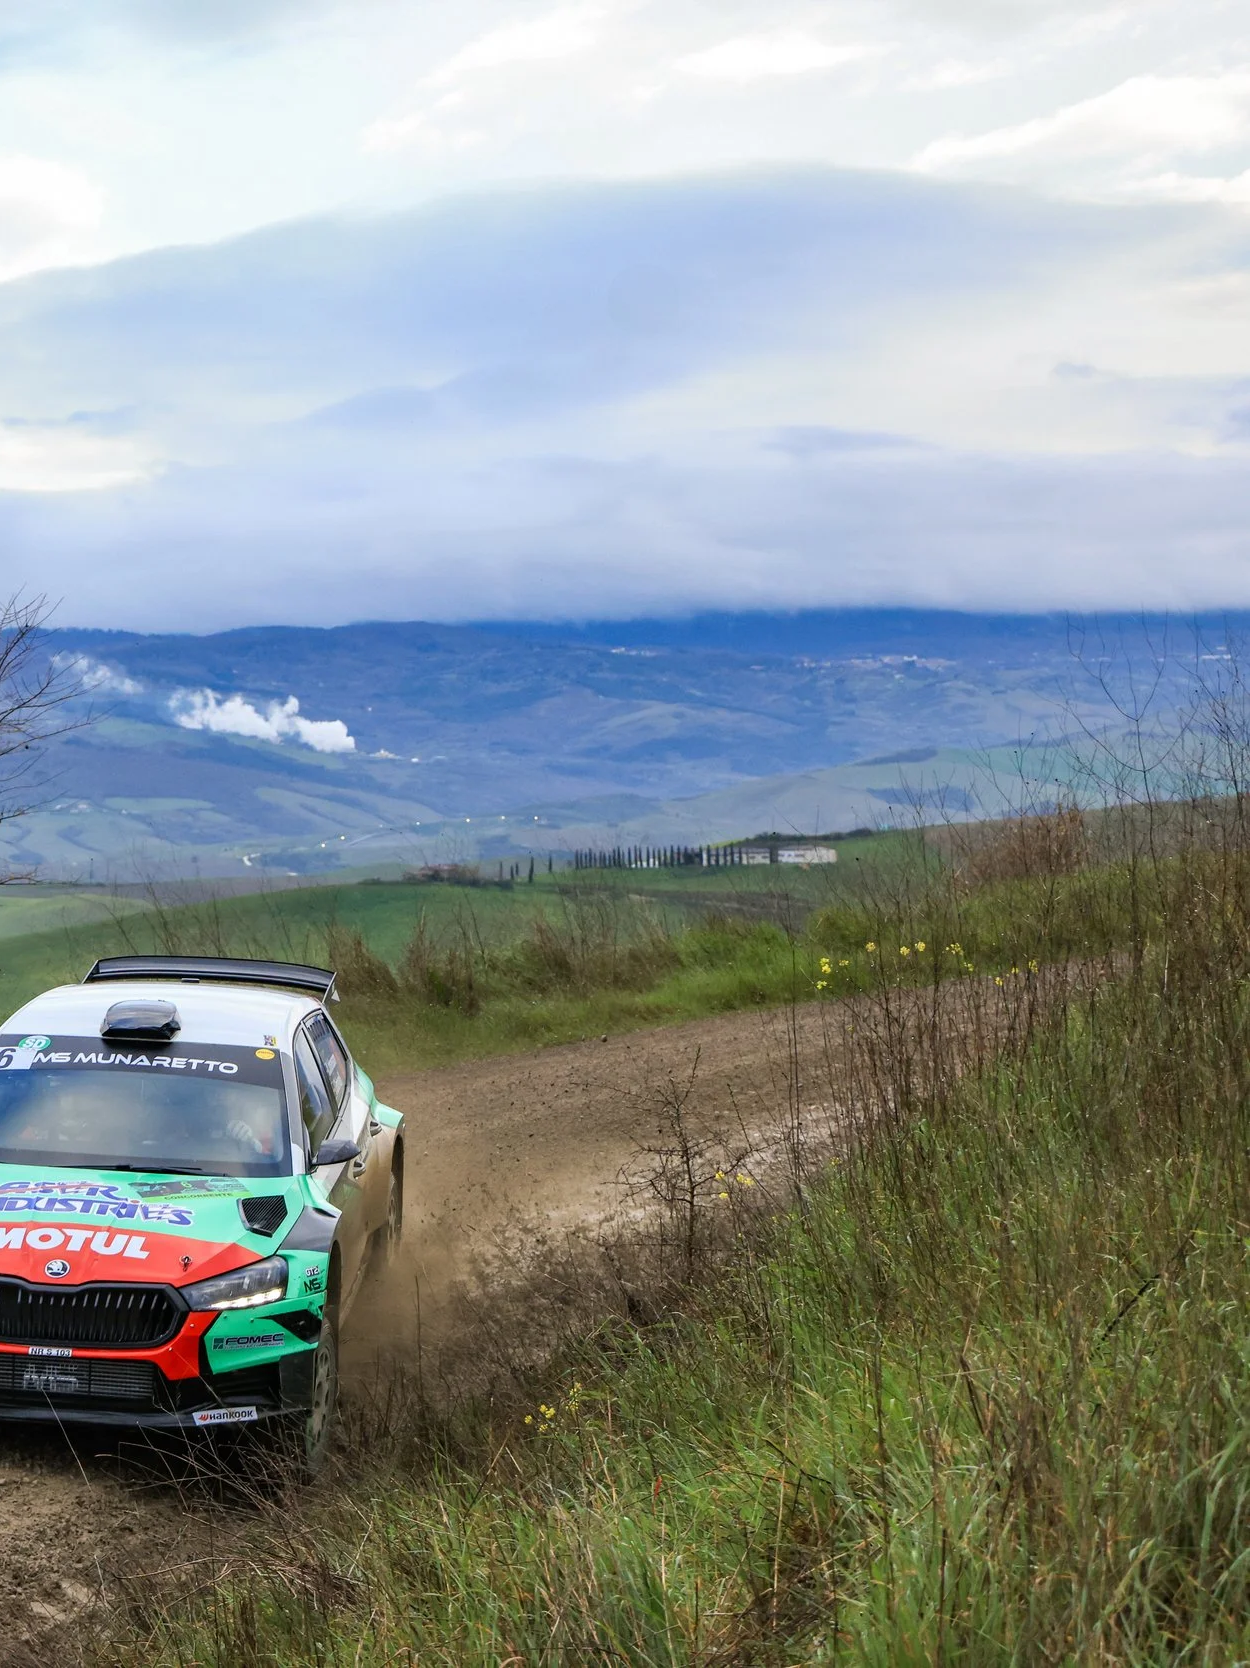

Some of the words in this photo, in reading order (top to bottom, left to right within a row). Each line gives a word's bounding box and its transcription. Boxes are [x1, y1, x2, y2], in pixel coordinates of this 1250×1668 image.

[23, 1037, 47, 1049] SD
[33, 1052, 72, 1063] MS
[73, 1051, 239, 1075] MUNARETTO
[225, 1332, 285, 1346] FOMEC
